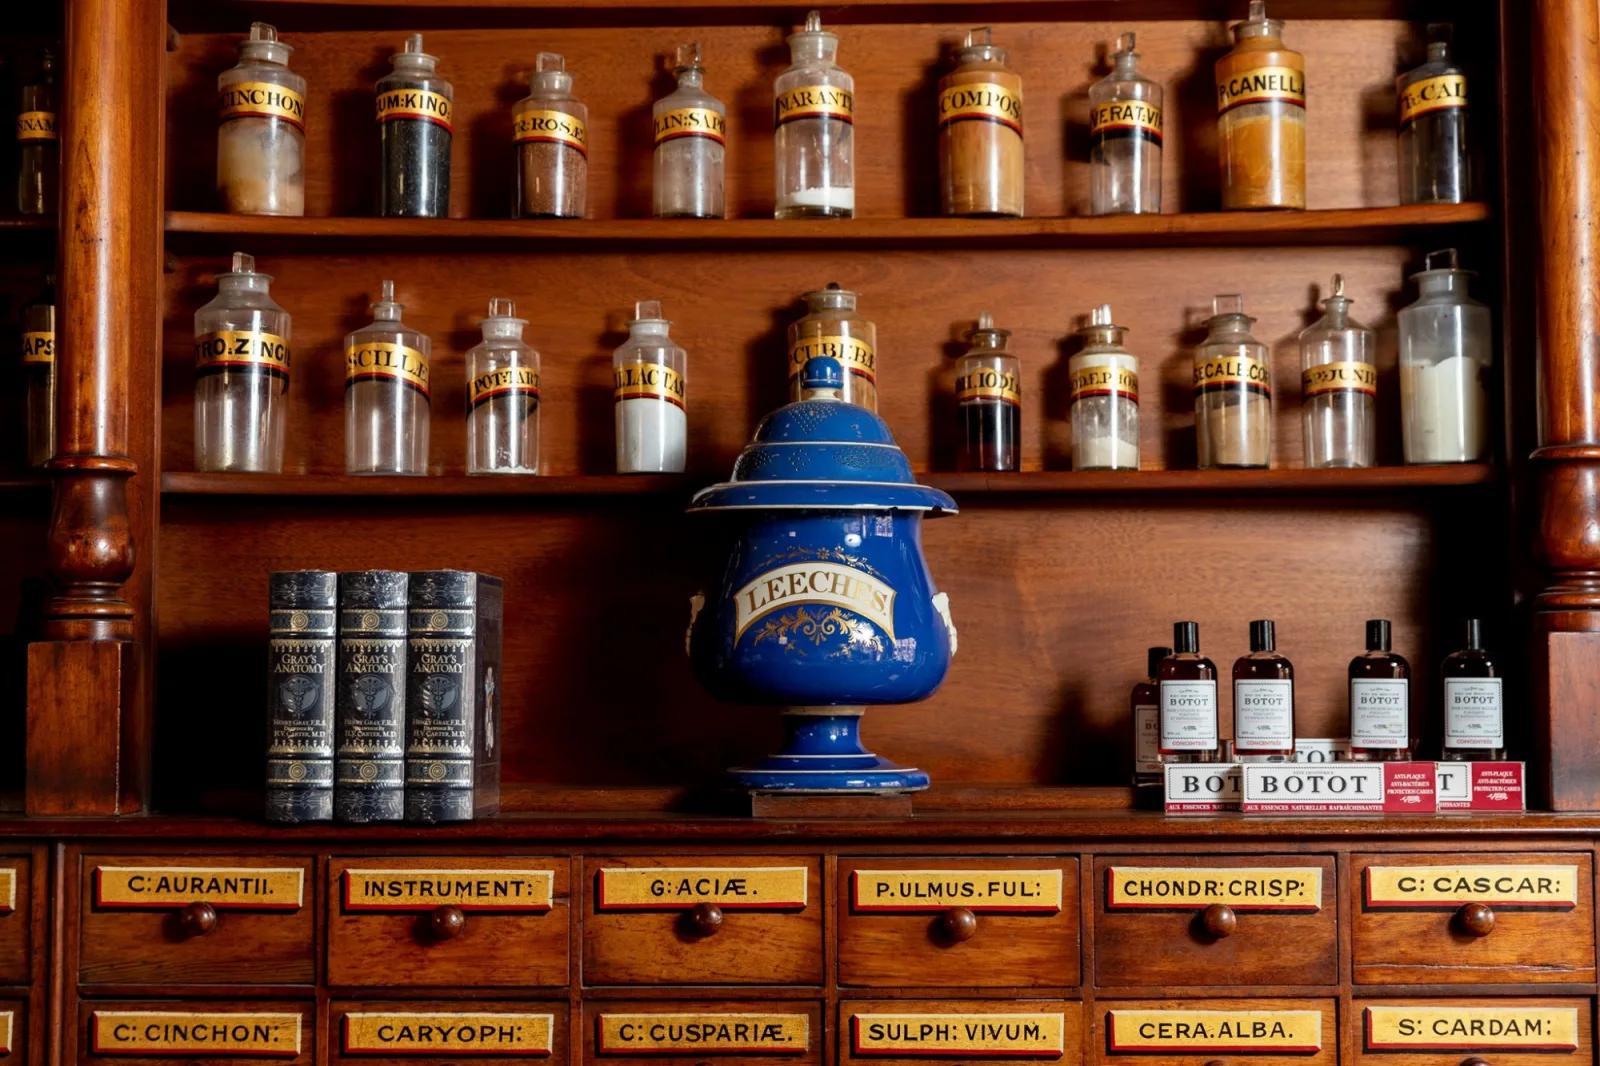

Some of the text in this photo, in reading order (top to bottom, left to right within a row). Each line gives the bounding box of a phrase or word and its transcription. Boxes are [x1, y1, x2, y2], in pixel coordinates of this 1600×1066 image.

[275, 664, 326, 673] ANATOMY
[345, 664, 397, 673] ANATOMY
[414, 664, 465, 673] ANATOMY
[1170, 698, 1208, 706] BOTOT
[1244, 697, 1283, 705] BOTOT
[1360, 696, 1400, 704] BOTOT
[1454, 695, 1495, 704] BOTOT
[1261, 775, 1367, 794] BOTOT
[364, 880, 533, 898] INSTRUMENT:
[1433, 877, 1561, 894] CASCAR:
[1432, 1018, 1552, 1036] CARDAM:
[377, 1024, 523, 1043] CARYOPH:
[965, 1023, 1047, 1042] VIVUM.
